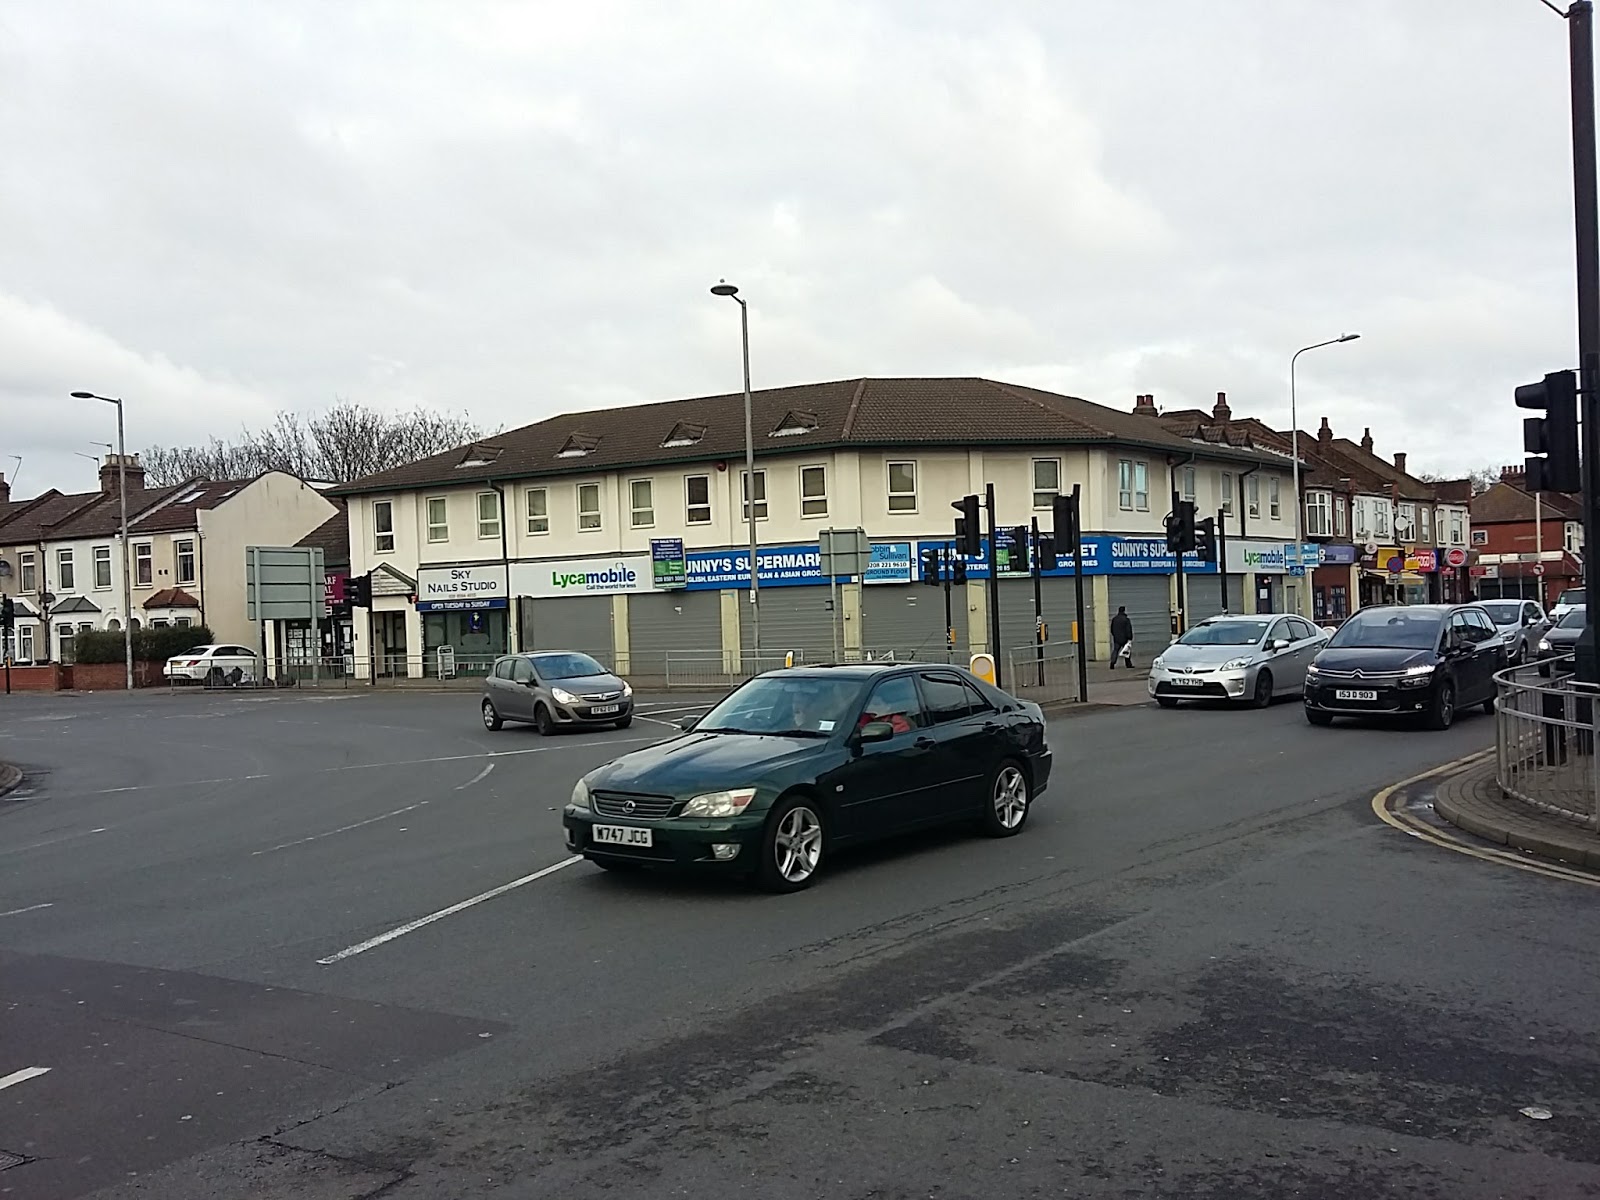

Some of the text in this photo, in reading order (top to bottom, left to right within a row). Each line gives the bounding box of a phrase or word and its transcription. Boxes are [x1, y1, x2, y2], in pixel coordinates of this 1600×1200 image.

[1112, 542, 1149, 557] SUNNY'S
[880, 552, 906, 560] Sullivan
[1244, 549, 1284, 566] Lycamobile
[686, 558, 732, 574] UNNY'S
[735, 553, 820, 571] SUPERMAR
[1058, 559, 1098, 567] GRORIES
[324, 576, 337, 585] ARF
[451, 569, 471, 580] SKY
[552, 567, 636, 589] Lycamobile
[688, 575, 707, 583] GLISH,
[707, 573, 736, 582] EASTERN
[737, 572, 773, 580] EURPEAN
[780, 570, 800, 578] ASIAN
[428, 581, 497, 593] NAILS STUDIO
[1358, 691, 1374, 699] 903
[627, 829, 648, 844] JCG
